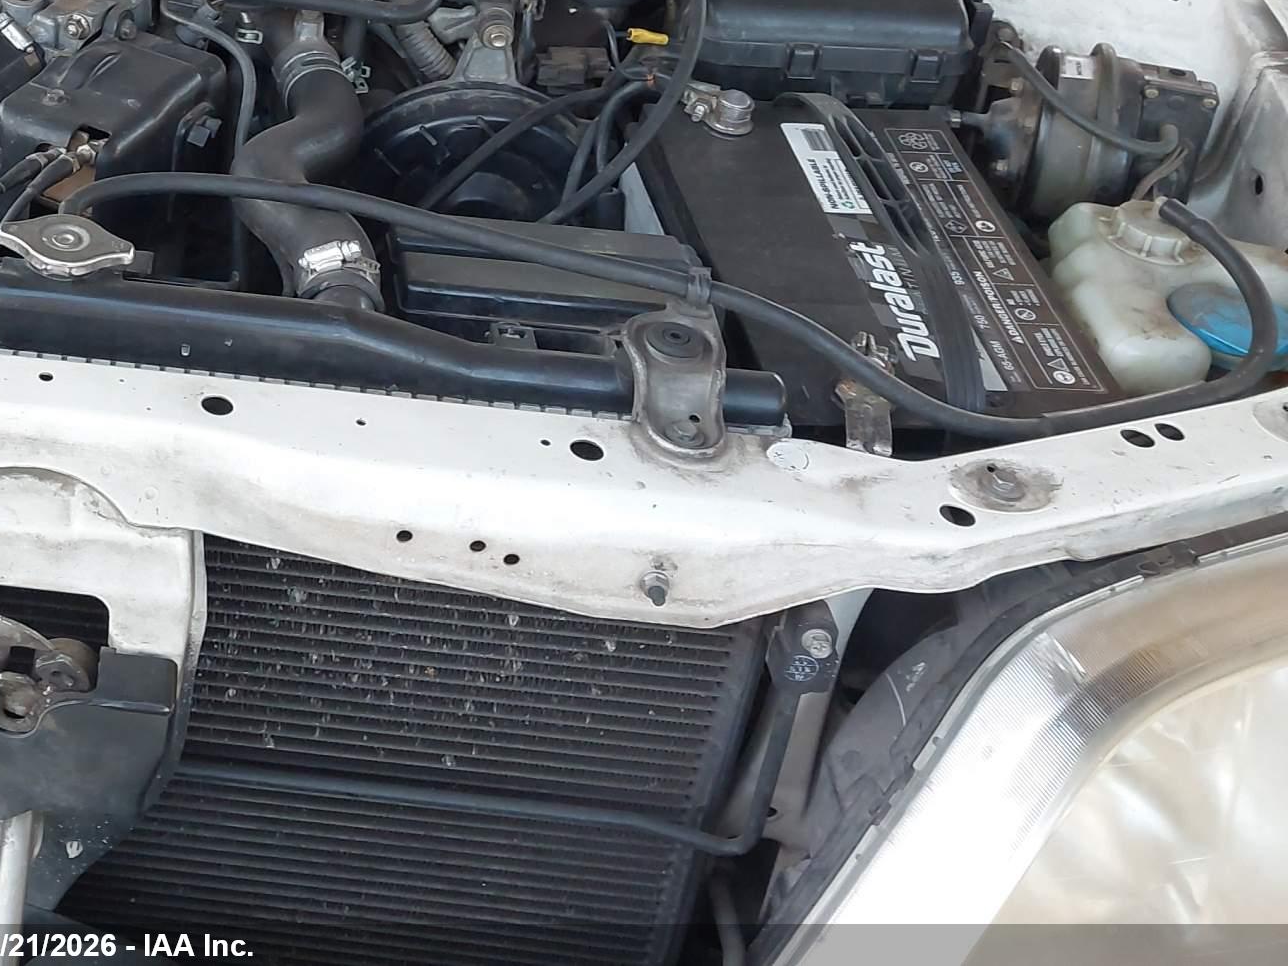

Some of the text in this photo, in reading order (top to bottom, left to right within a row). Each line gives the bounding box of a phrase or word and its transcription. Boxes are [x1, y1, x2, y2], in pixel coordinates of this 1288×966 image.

[807, 158, 839, 210] NON-SPILLABLE
[849, 241, 940, 361] Duralast
[951, 271, 1015, 371] 65-AGM 750 935
[973, 270, 1020, 336] DANGER/POISON
